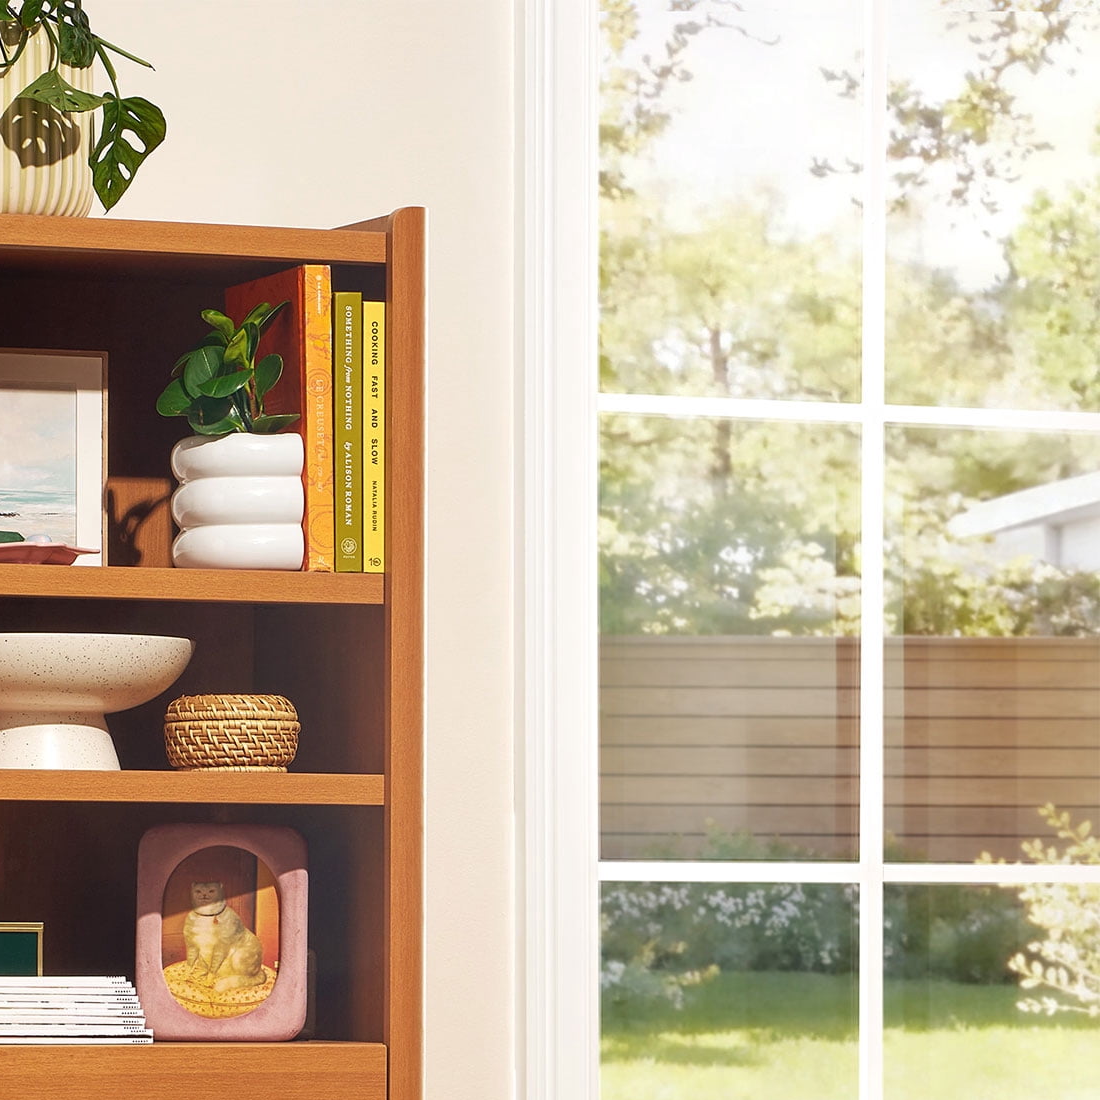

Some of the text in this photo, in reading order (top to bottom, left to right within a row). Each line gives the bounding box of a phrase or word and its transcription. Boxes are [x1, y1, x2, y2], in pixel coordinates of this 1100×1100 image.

[344, 364, 352, 383] from
[371, 321, 379, 465] COOKING FAST AND SLOW
[316, 395, 325, 445] CREUSET
[344, 441, 353, 451] by
